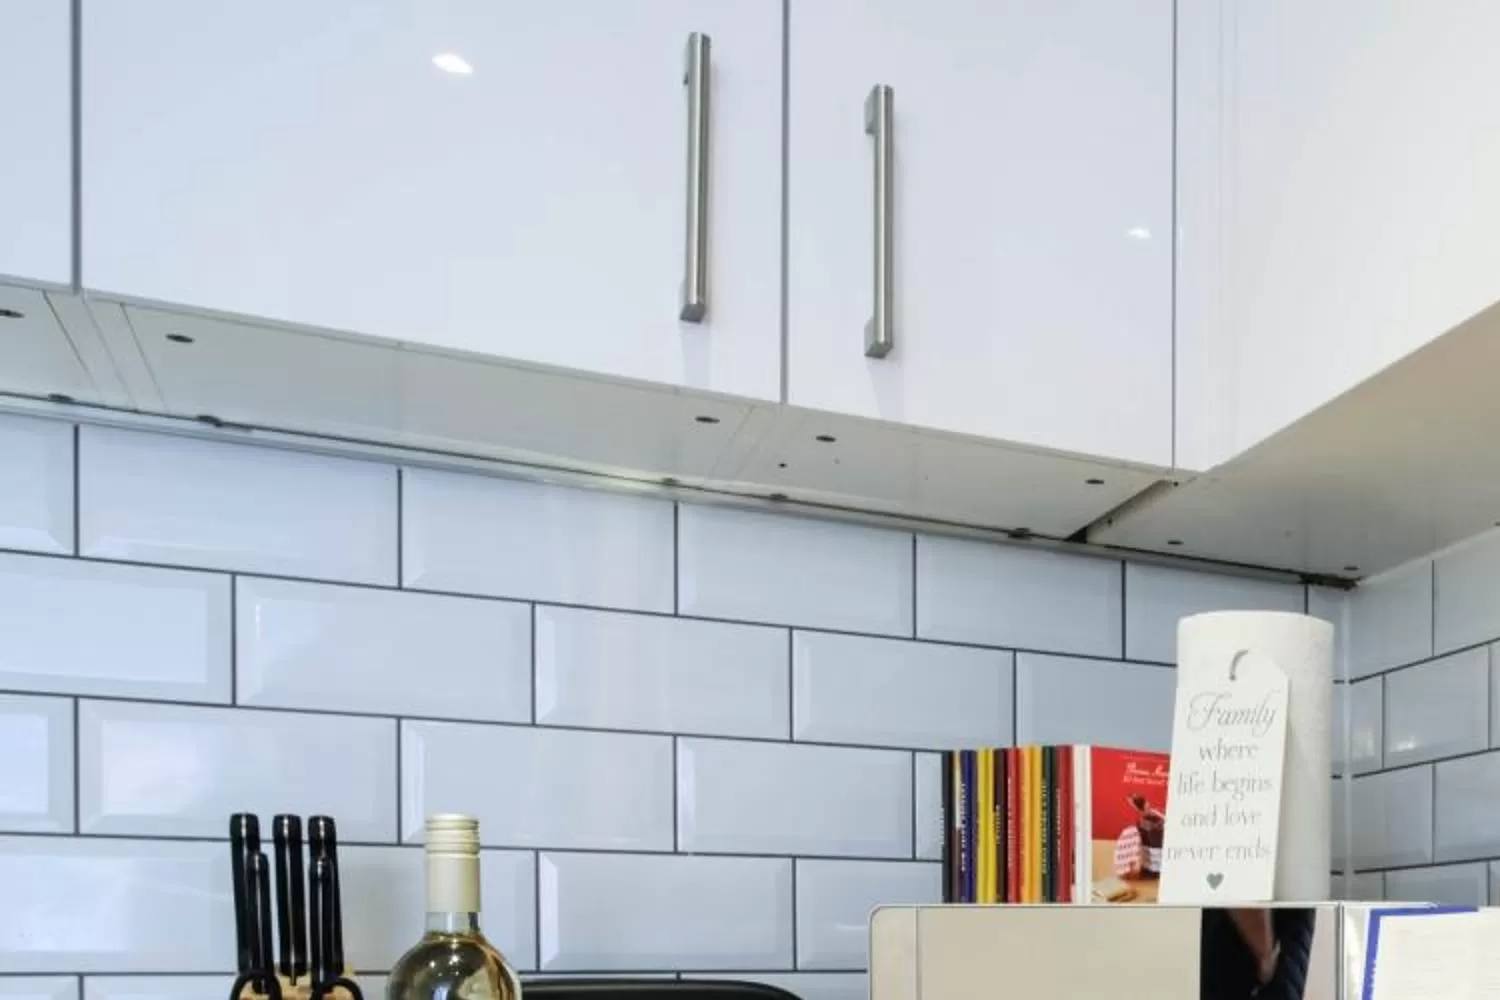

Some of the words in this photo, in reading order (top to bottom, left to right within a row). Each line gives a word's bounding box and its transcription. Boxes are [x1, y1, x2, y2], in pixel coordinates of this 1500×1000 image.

[1186, 692, 1279, 737] Family
[1199, 737, 1258, 761] where
[1178, 771, 1206, 796] life
[1212, 770, 1274, 801] begins
[1181, 804, 1218, 828] and
[1225, 803, 1262, 827] love
[1166, 846, 1222, 861] never
[1225, 836, 1273, 861] ends
